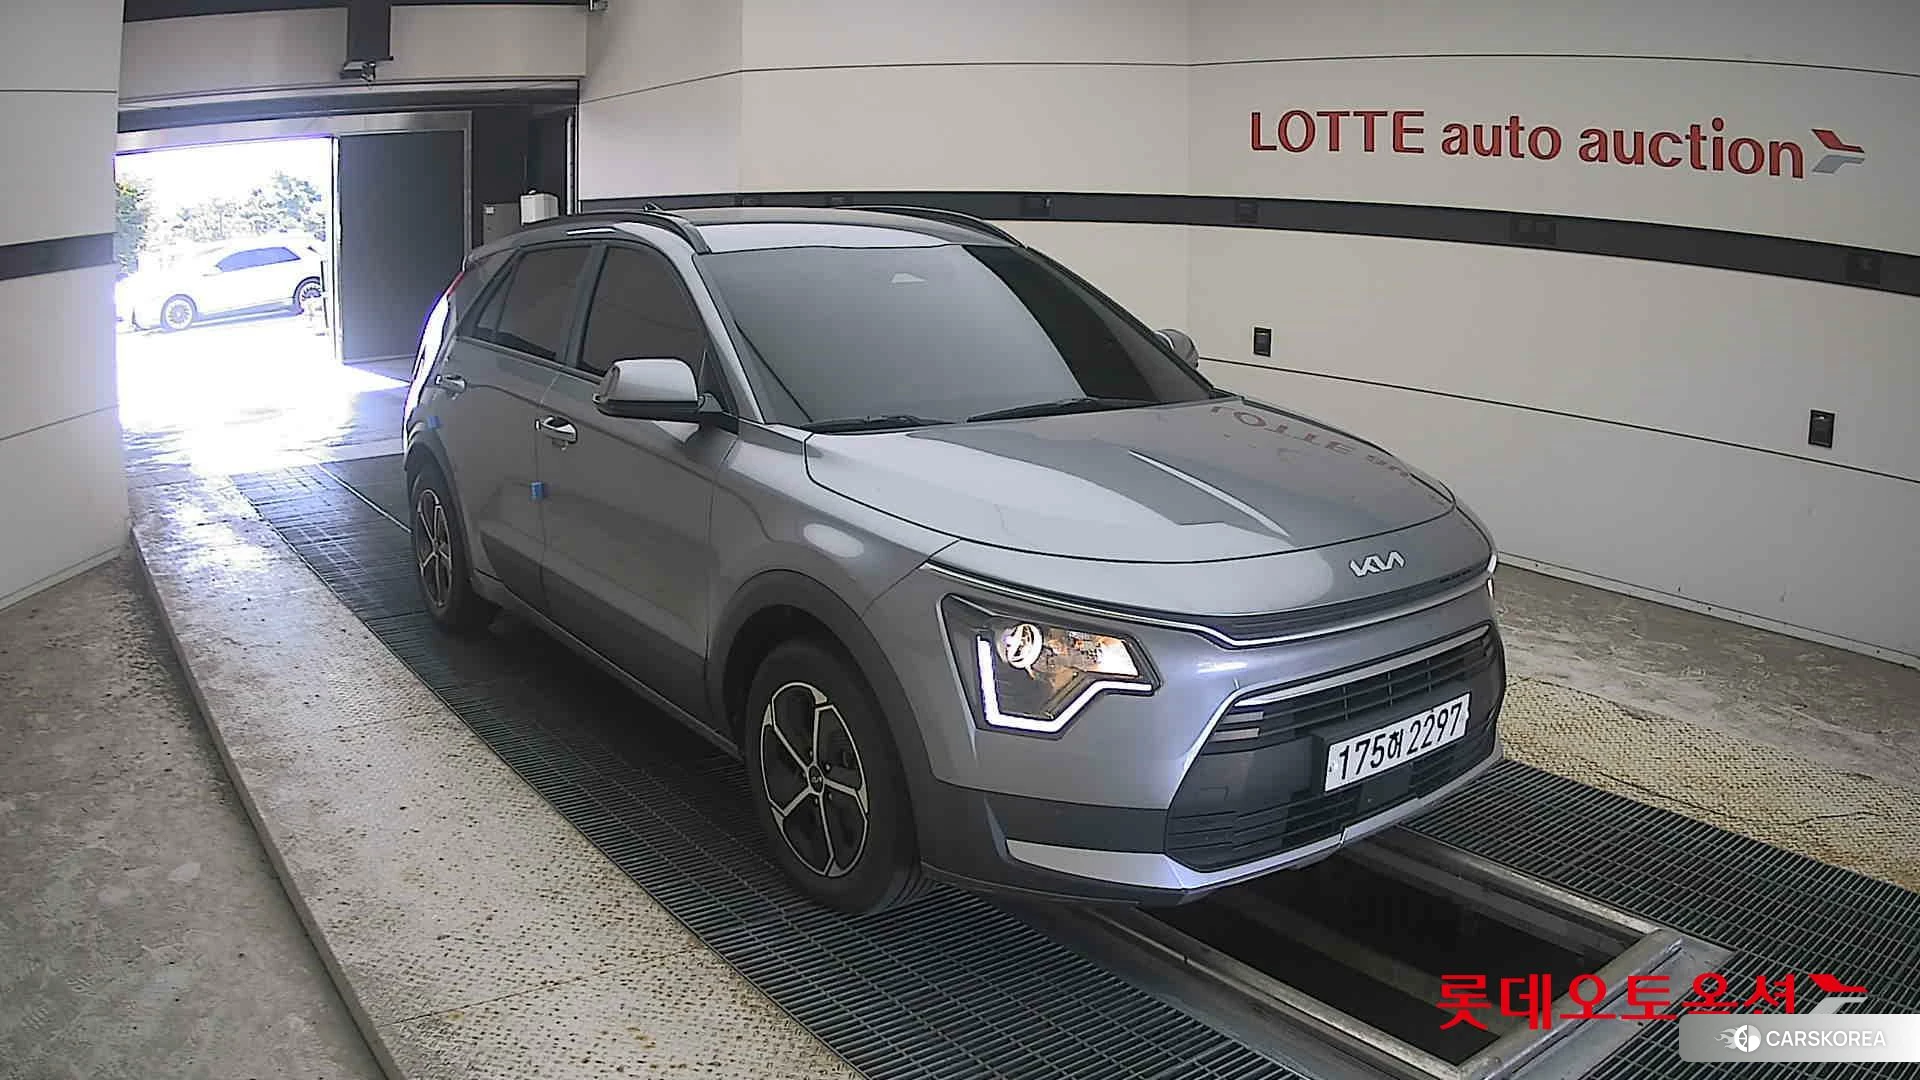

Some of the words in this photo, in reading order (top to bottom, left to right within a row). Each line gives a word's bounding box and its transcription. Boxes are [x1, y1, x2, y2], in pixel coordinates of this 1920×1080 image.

[1250, 110, 1425, 154] LOTTE
[1441, 115, 1562, 161] auto
[1578, 117, 1804, 179] auction
